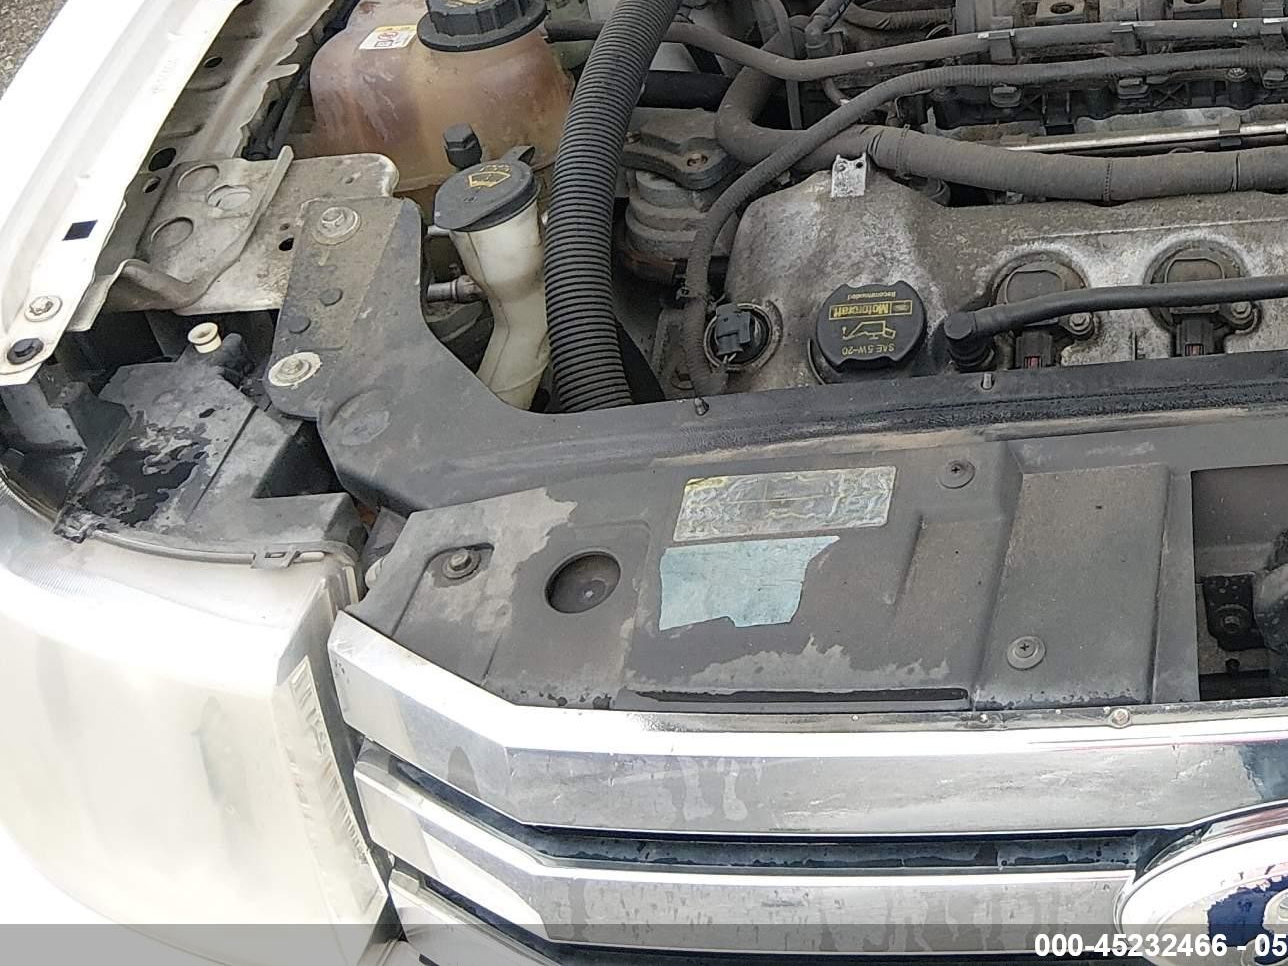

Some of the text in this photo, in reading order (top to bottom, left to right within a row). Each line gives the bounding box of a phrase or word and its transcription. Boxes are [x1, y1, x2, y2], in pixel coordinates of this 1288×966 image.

[833, 302, 889, 318] Motorcraft
[841, 343, 895, 356] SAE 5W-20
